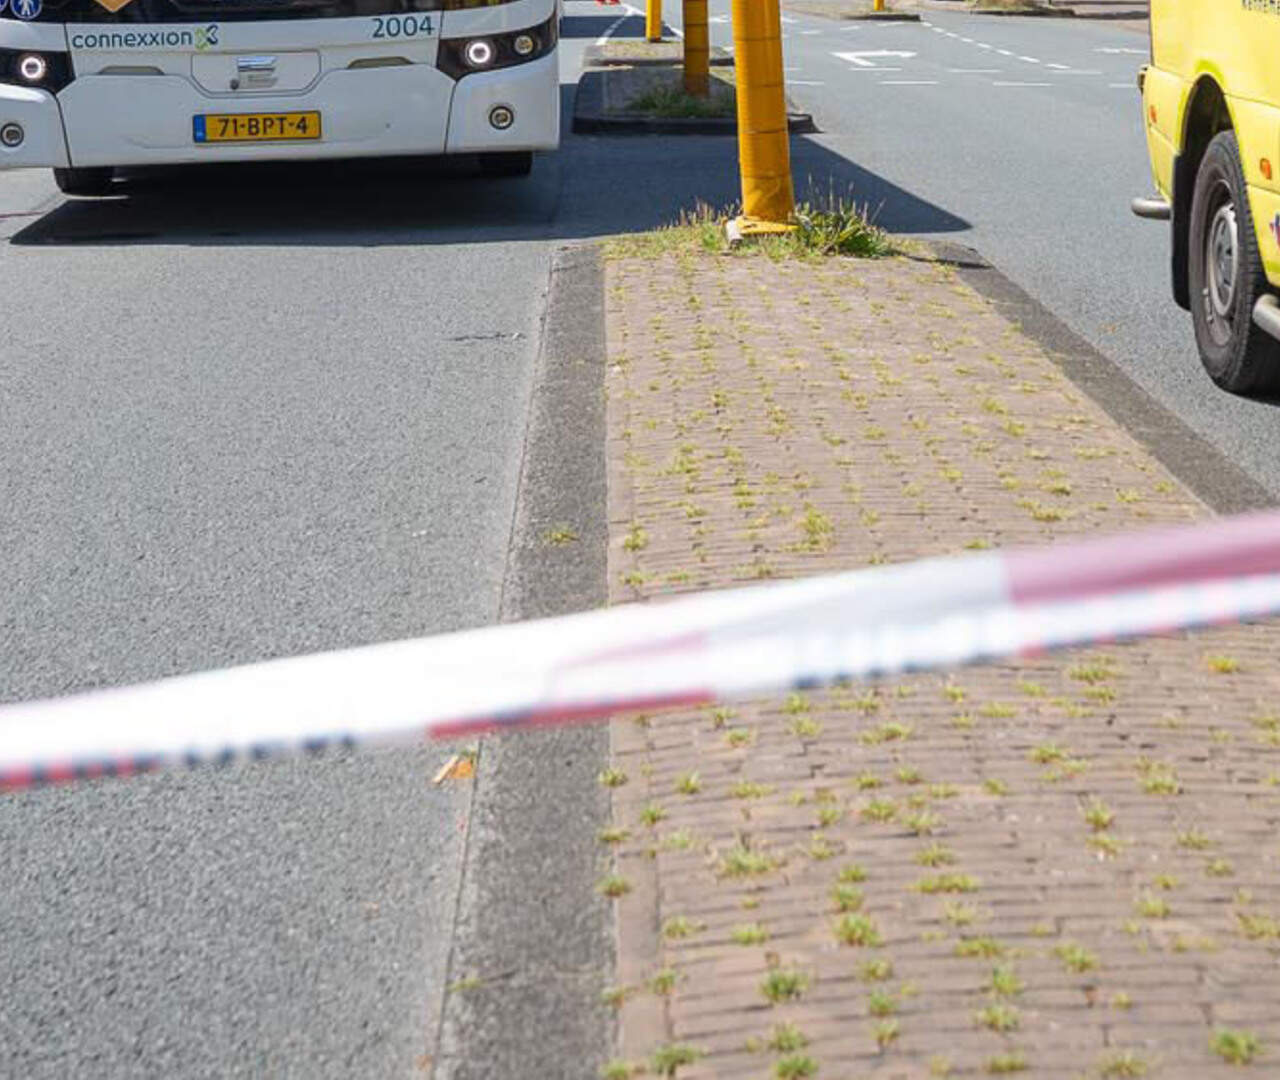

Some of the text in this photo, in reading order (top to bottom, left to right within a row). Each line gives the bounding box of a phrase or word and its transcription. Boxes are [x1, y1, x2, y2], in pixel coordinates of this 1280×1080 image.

[372, 16, 435, 38] 2004
[72, 31, 193, 49] connexxion
[217, 116, 309, 137] 71-BPT-4
